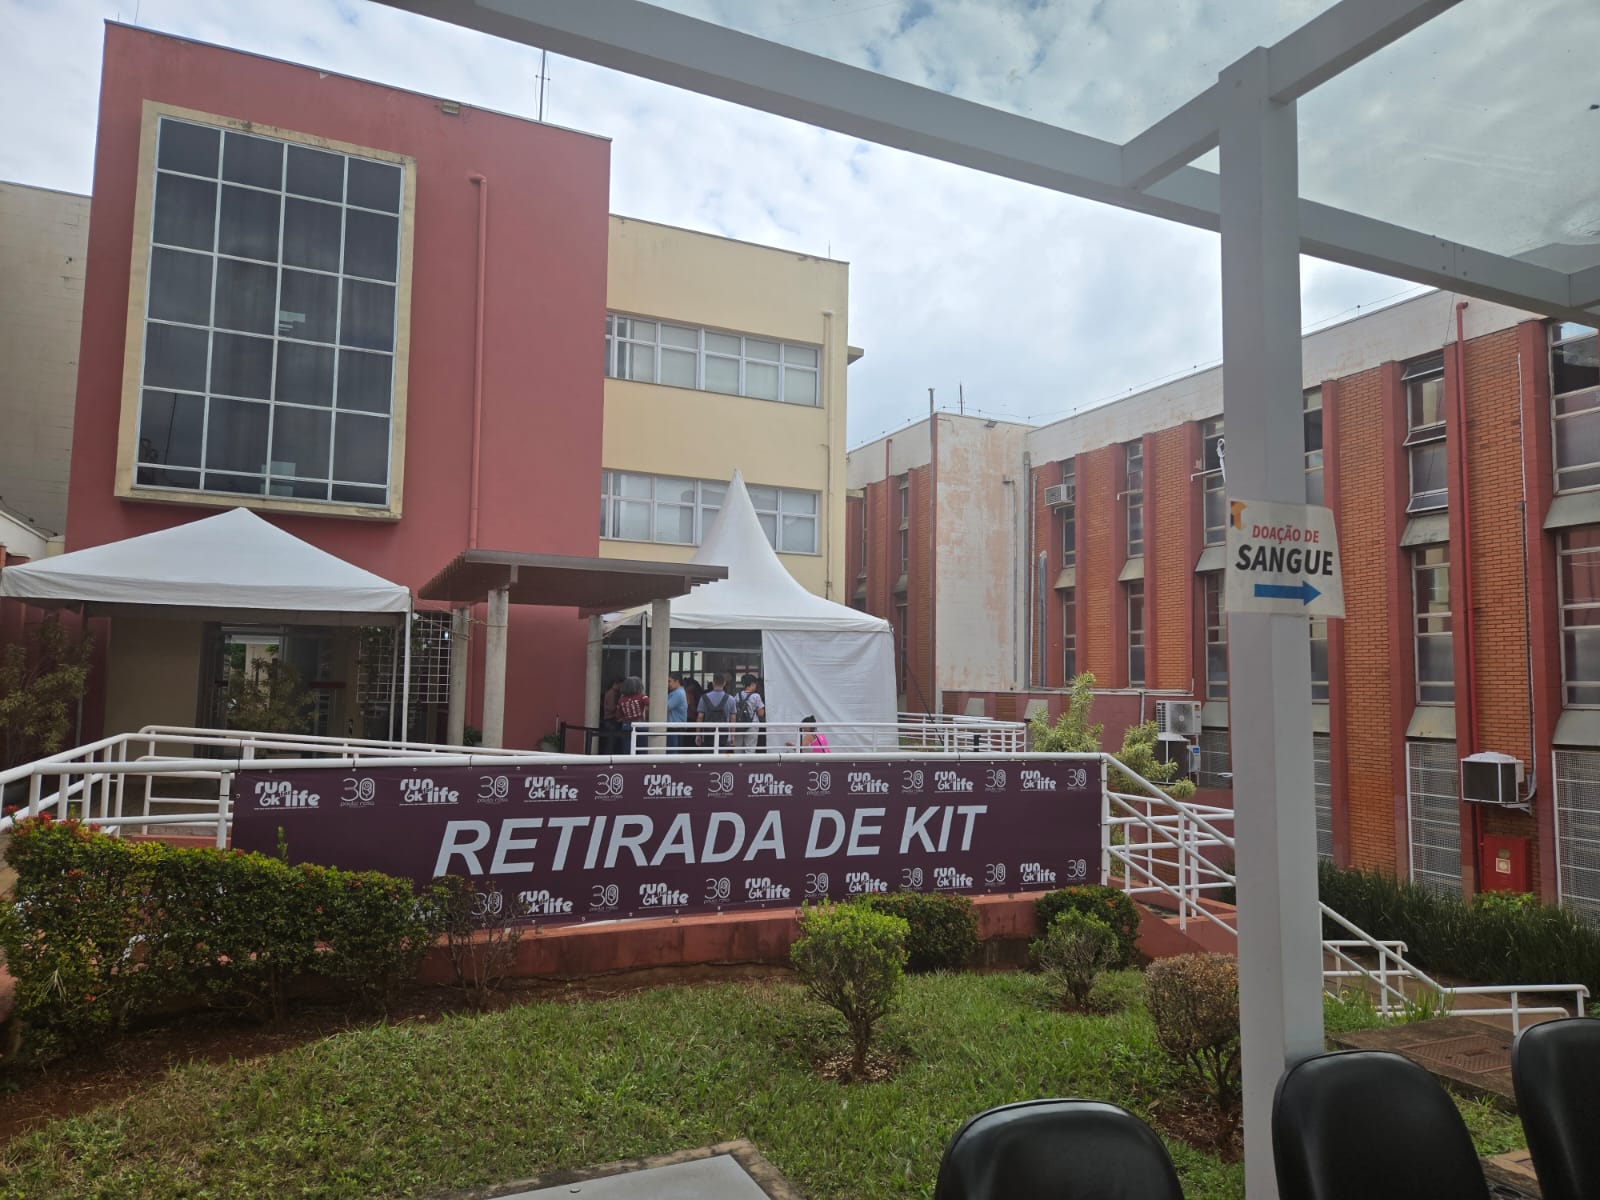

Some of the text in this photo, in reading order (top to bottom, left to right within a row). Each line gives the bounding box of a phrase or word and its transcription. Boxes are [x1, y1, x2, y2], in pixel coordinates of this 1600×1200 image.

[1252, 525, 1319, 544] DOAÇÃO DE
[1235, 544, 1333, 576] SANGUE
[399, 779, 434, 791] run
[524, 776, 555, 788] run
[643, 774, 671, 785] run
[748, 773, 774, 784] run
[254, 780, 292, 794] run
[549, 785, 579, 800] life
[666, 782, 693, 796] life
[769, 781, 794, 795] life
[285, 790, 321, 806] life
[427, 787, 460, 803] life
[433, 805, 988, 877] RETIRADA DE KIT
[639, 883, 667, 894] run
[745, 877, 771, 888] run
[662, 891, 689, 905] life
[766, 885, 791, 899] life
[544, 898, 574, 914] life
